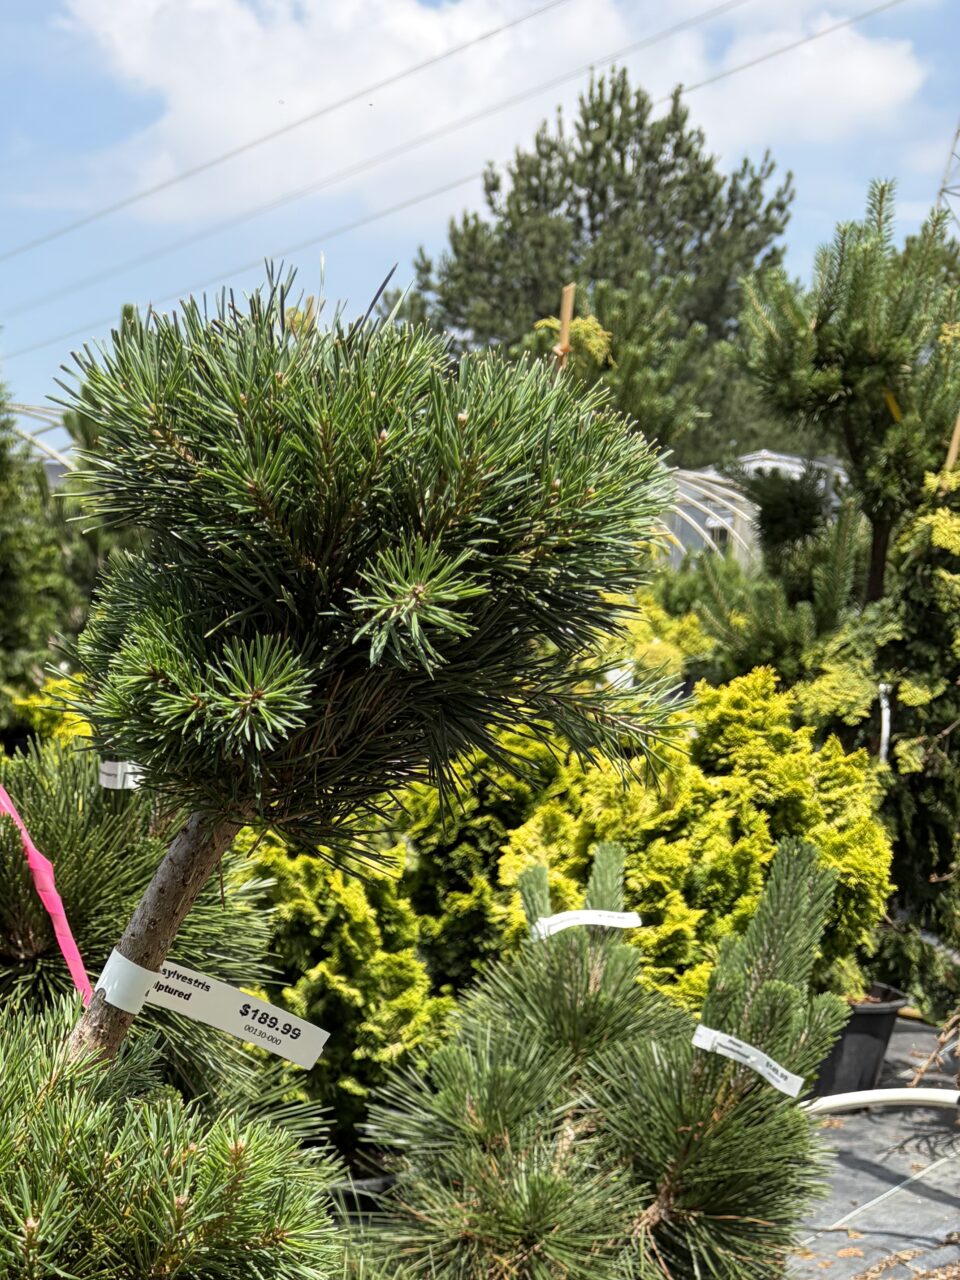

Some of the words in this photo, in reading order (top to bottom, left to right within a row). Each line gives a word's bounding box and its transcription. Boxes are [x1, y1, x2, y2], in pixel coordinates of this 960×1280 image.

[153, 980, 193, 1001] lptured
[161, 967, 211, 992] sylvestris
[239, 1003, 302, 1040] $189.99
[243, 1024, 282, 1046] 00130-000
